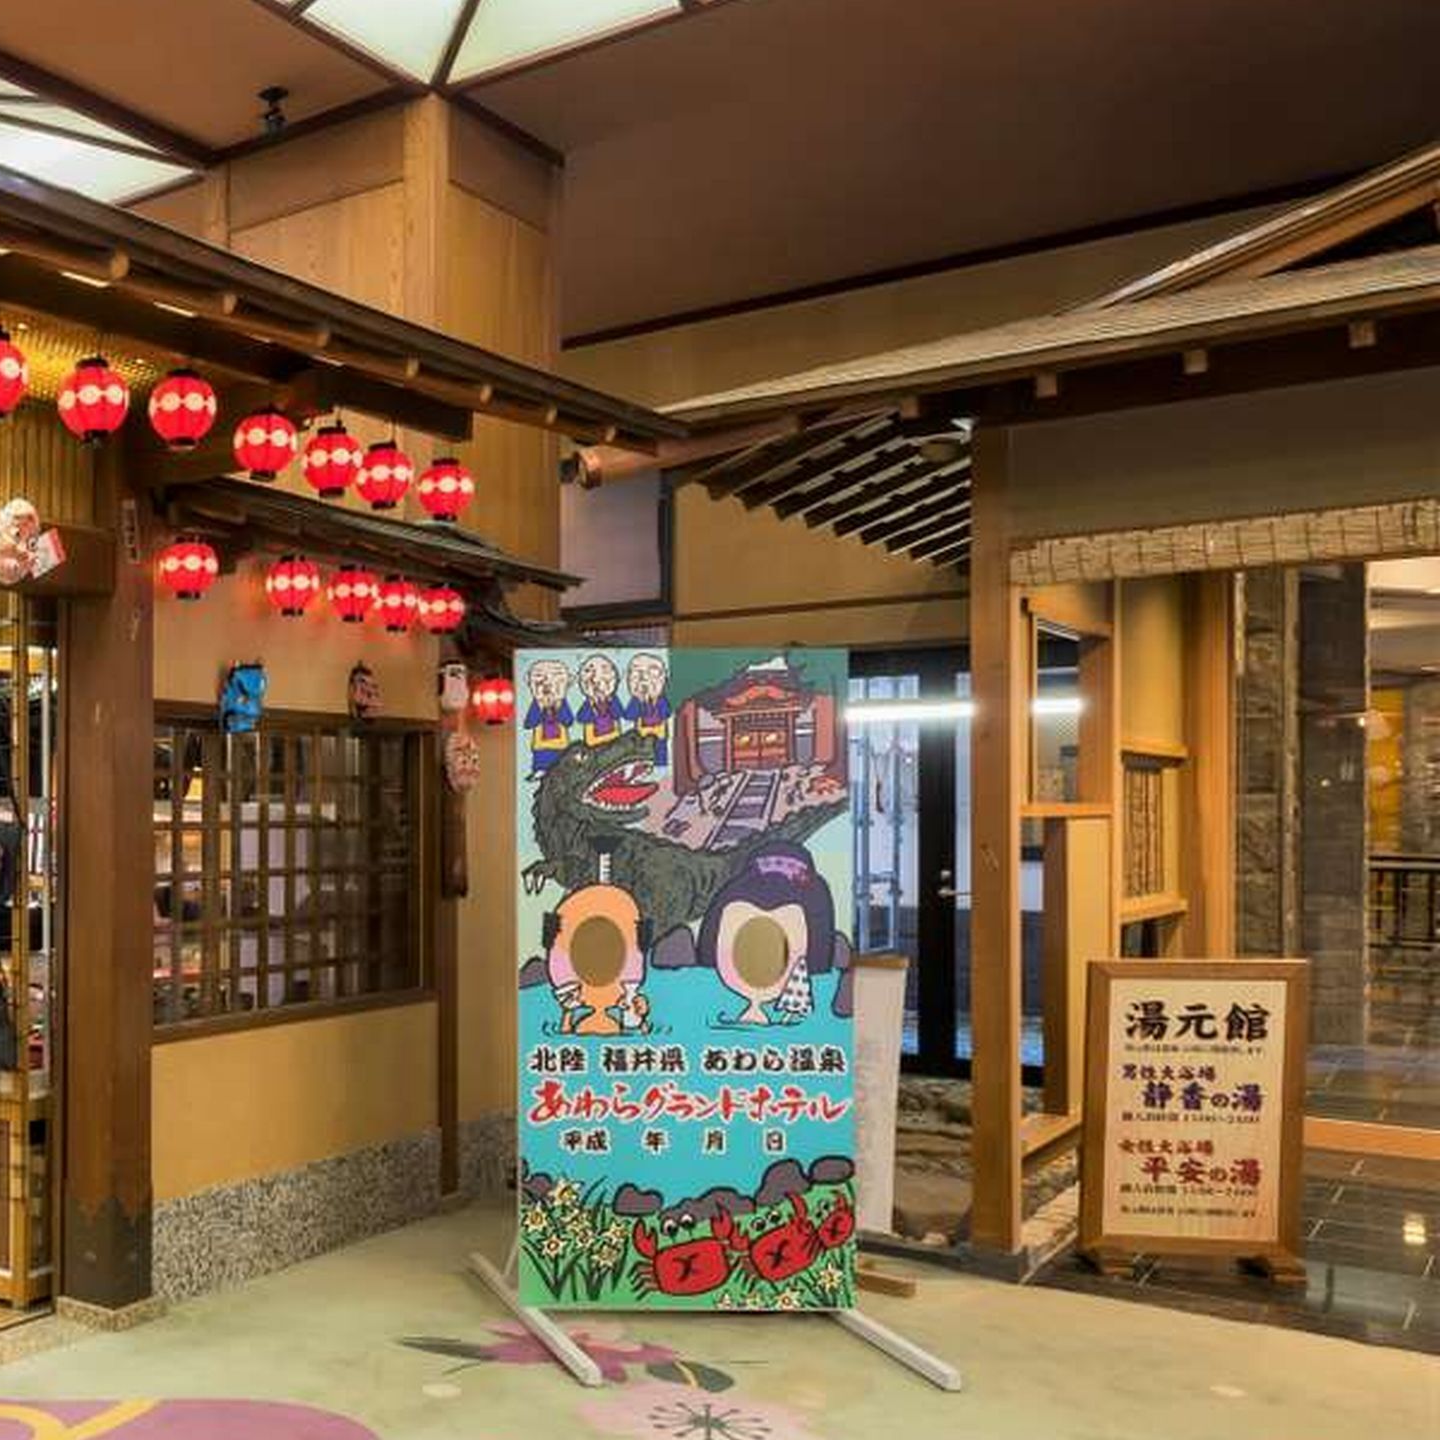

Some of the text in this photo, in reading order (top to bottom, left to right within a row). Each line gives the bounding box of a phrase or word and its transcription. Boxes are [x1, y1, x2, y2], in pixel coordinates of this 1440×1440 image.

[1125, 999, 1271, 1042] 湯元館
[530, 1047, 847, 1073] 北陸 福井県 あわら温泉
[1121, 1063, 1217, 1083] 男性大浴場
[530, 1079, 847, 1124] あわらグランドホテル
[1141, 1080, 1266, 1112] 静香の湯
[563, 1131, 784, 1151] 平成 年 月 日
[1117, 1139, 1215, 1156] 女性大浴場
[1139, 1156, 1262, 1186] 平安の湯
